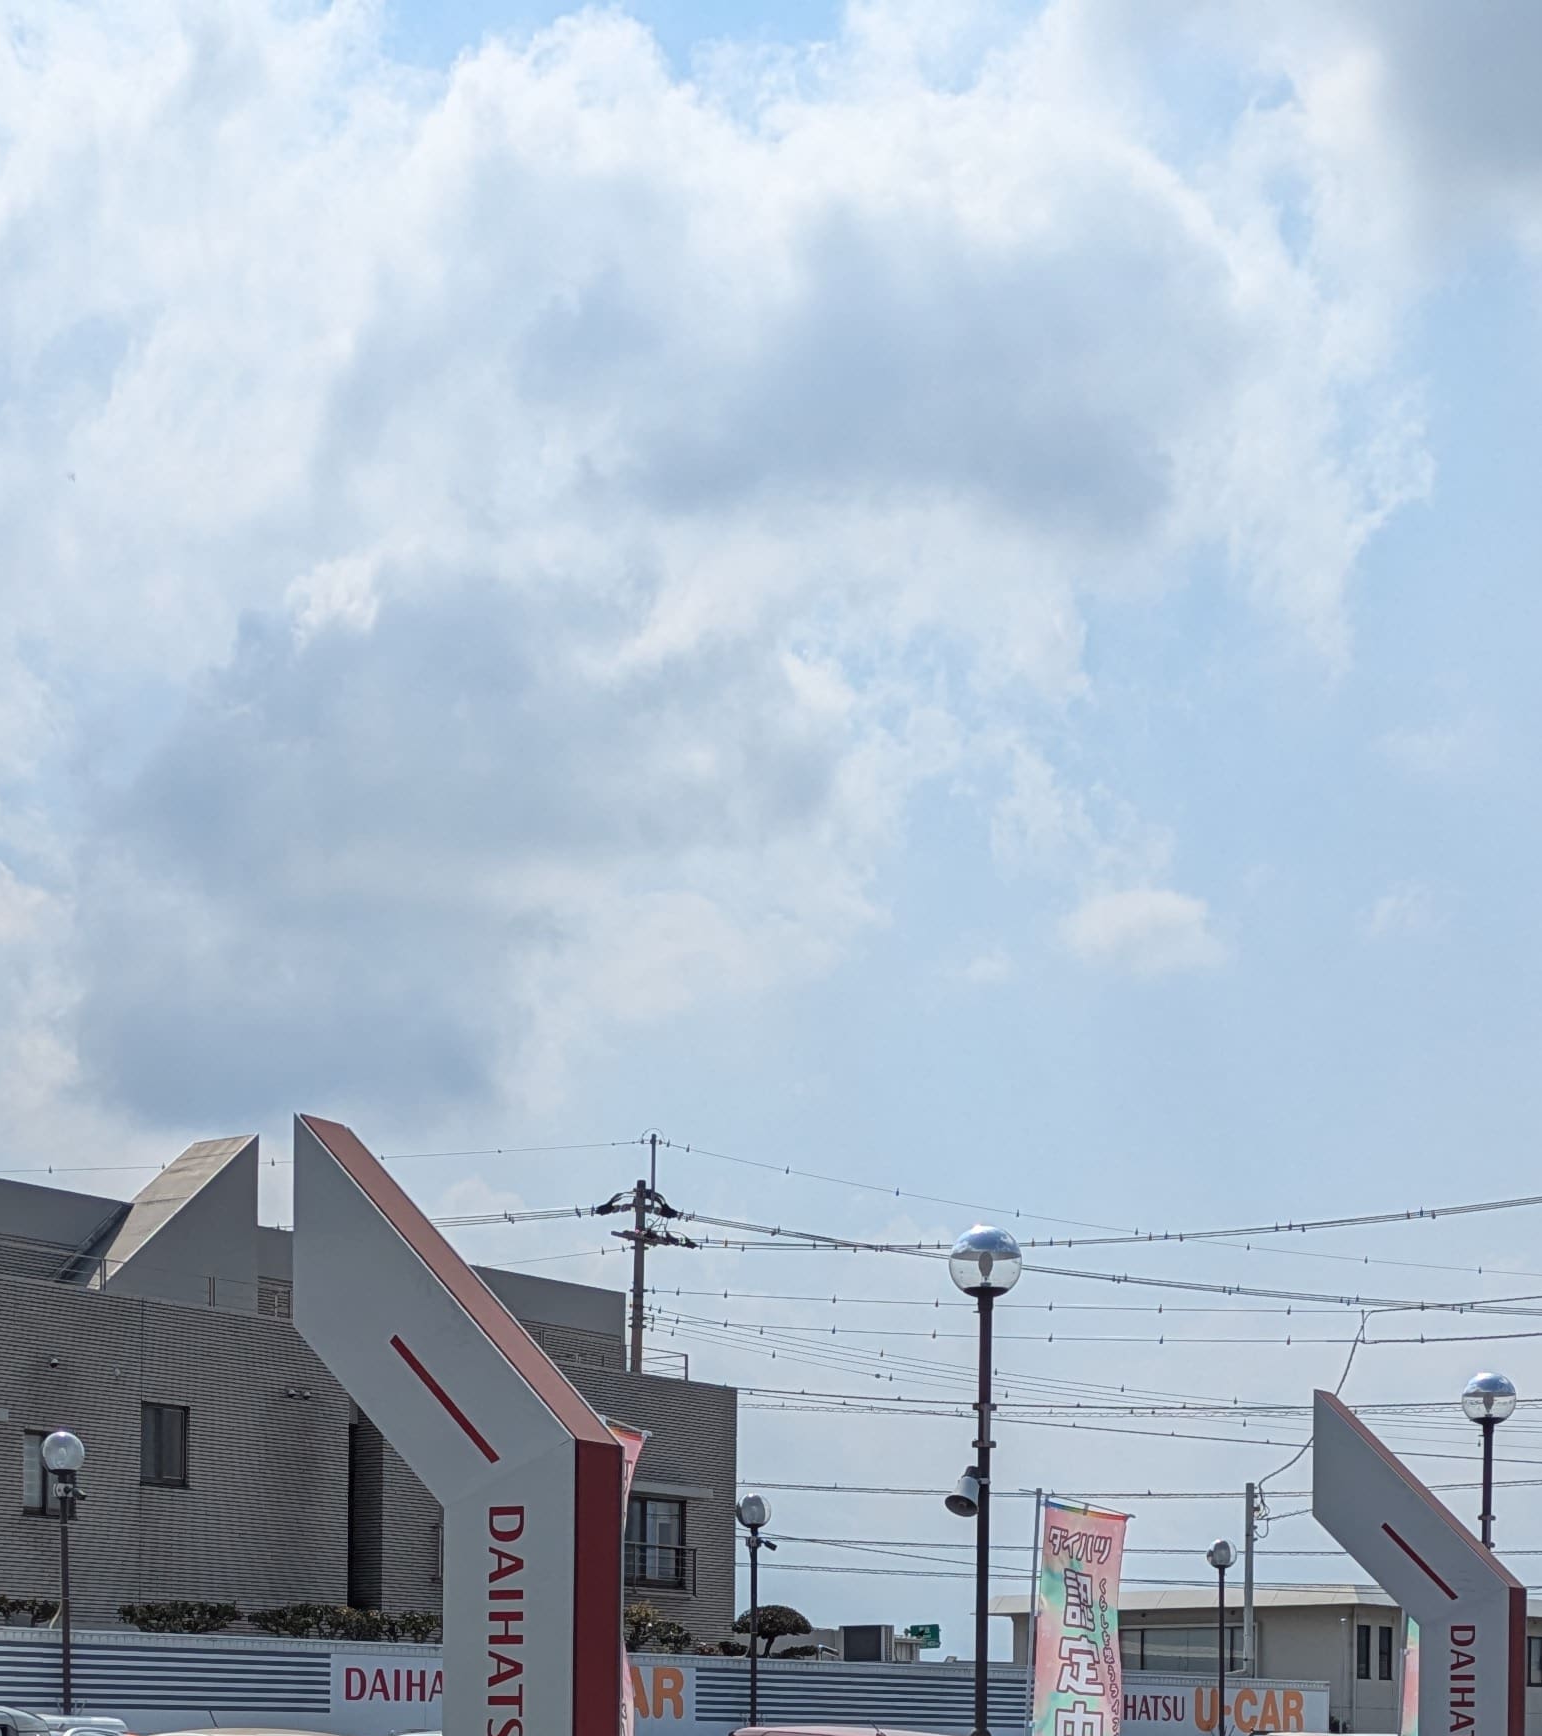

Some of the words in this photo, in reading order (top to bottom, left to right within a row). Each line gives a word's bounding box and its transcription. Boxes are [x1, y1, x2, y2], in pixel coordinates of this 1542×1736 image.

[1049, 1526, 1112, 1564] ダイハツ
[345, 1667, 443, 1702] DAIHA
[1124, 1694, 1185, 1722] HATSU
[1194, 1686, 1304, 1733] U-CAR
